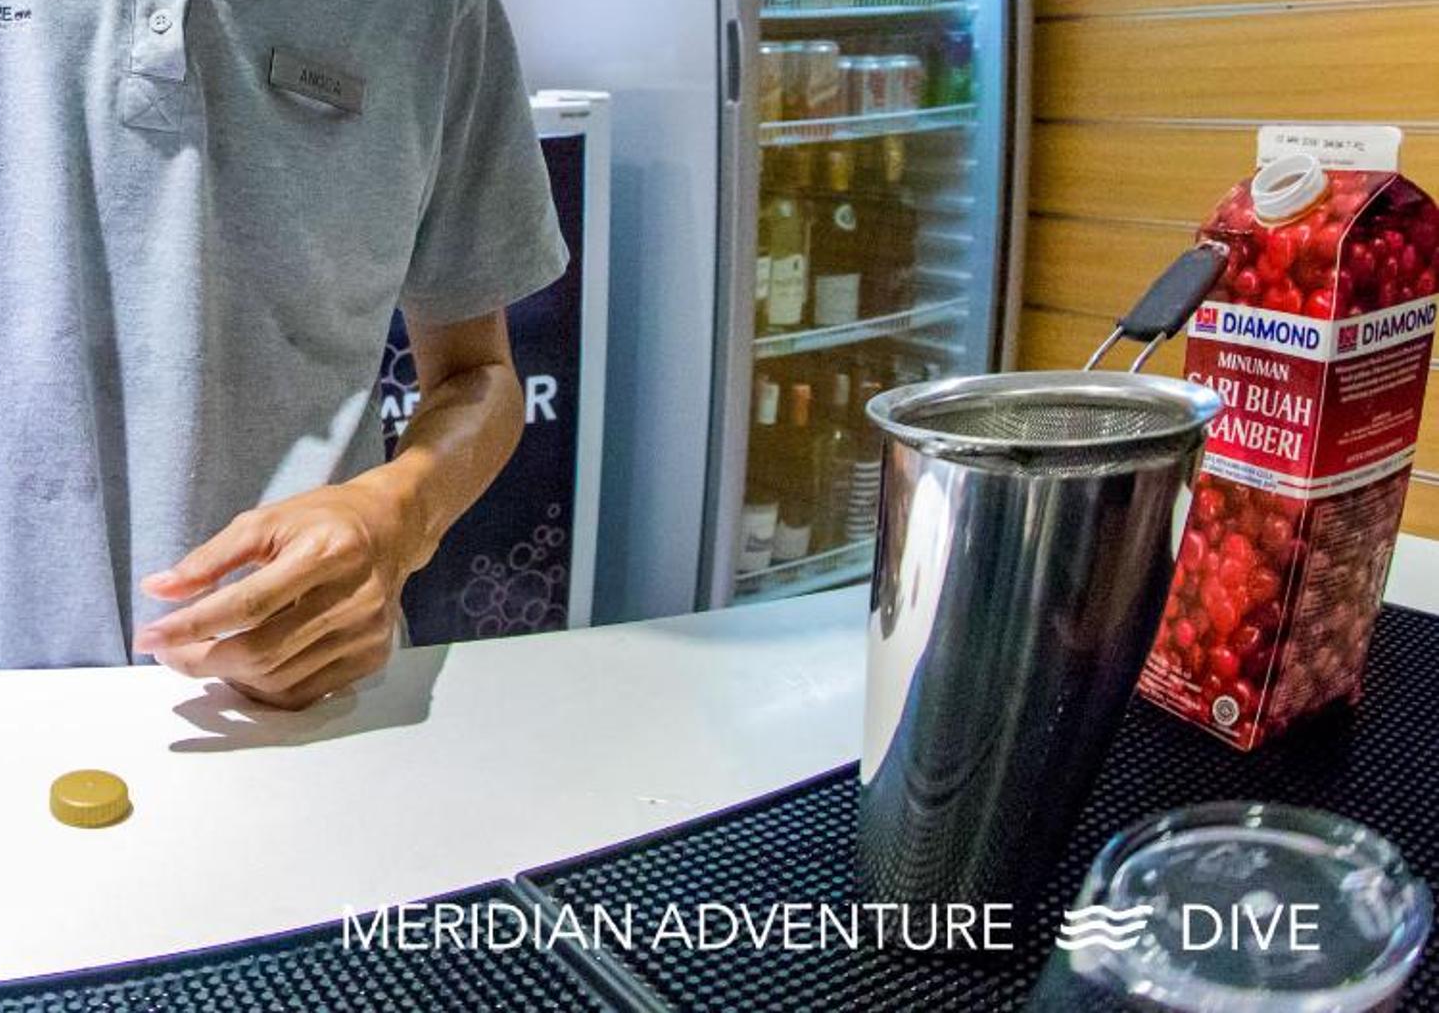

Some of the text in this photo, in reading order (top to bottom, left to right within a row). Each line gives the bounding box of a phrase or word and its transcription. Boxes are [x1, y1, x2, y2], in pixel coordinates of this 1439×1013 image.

[1222, 312, 1320, 350] DIAMOND
[1362, 304, 1437, 346] DIAMOND
[1217, 351, 1290, 381] MINUMAN
[1244, 384, 1313, 427] BUAH
